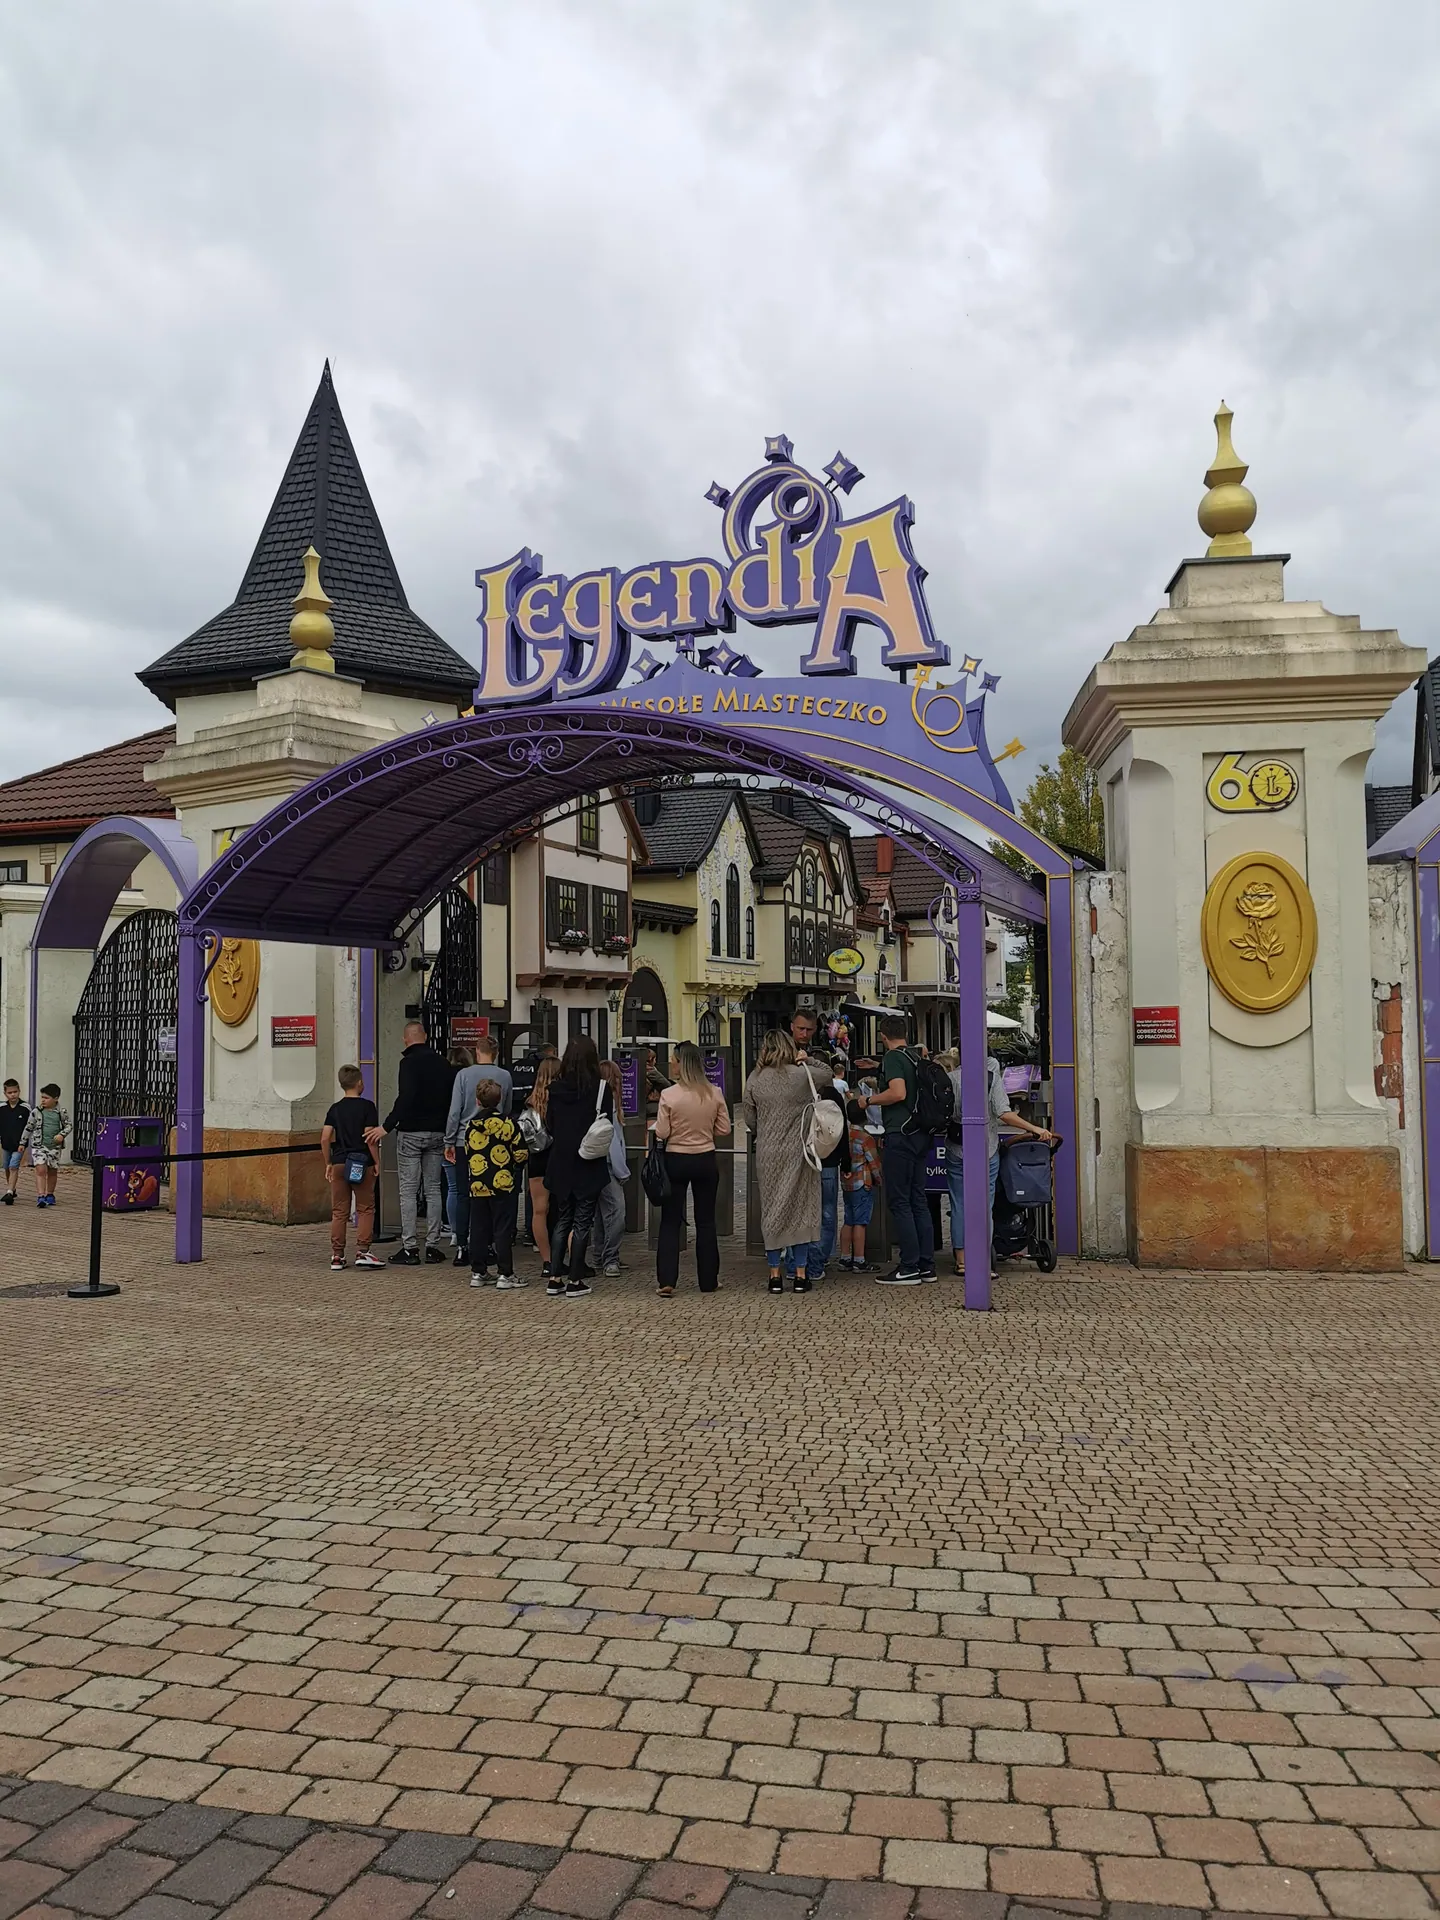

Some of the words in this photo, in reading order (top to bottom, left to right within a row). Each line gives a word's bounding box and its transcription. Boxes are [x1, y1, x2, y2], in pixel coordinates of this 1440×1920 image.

[803, 996, 809, 1004] 5
[902, 995, 909, 1004] 6
[543, 1001, 548, 1009] 2
[513, 1065, 535, 1073] NASA
